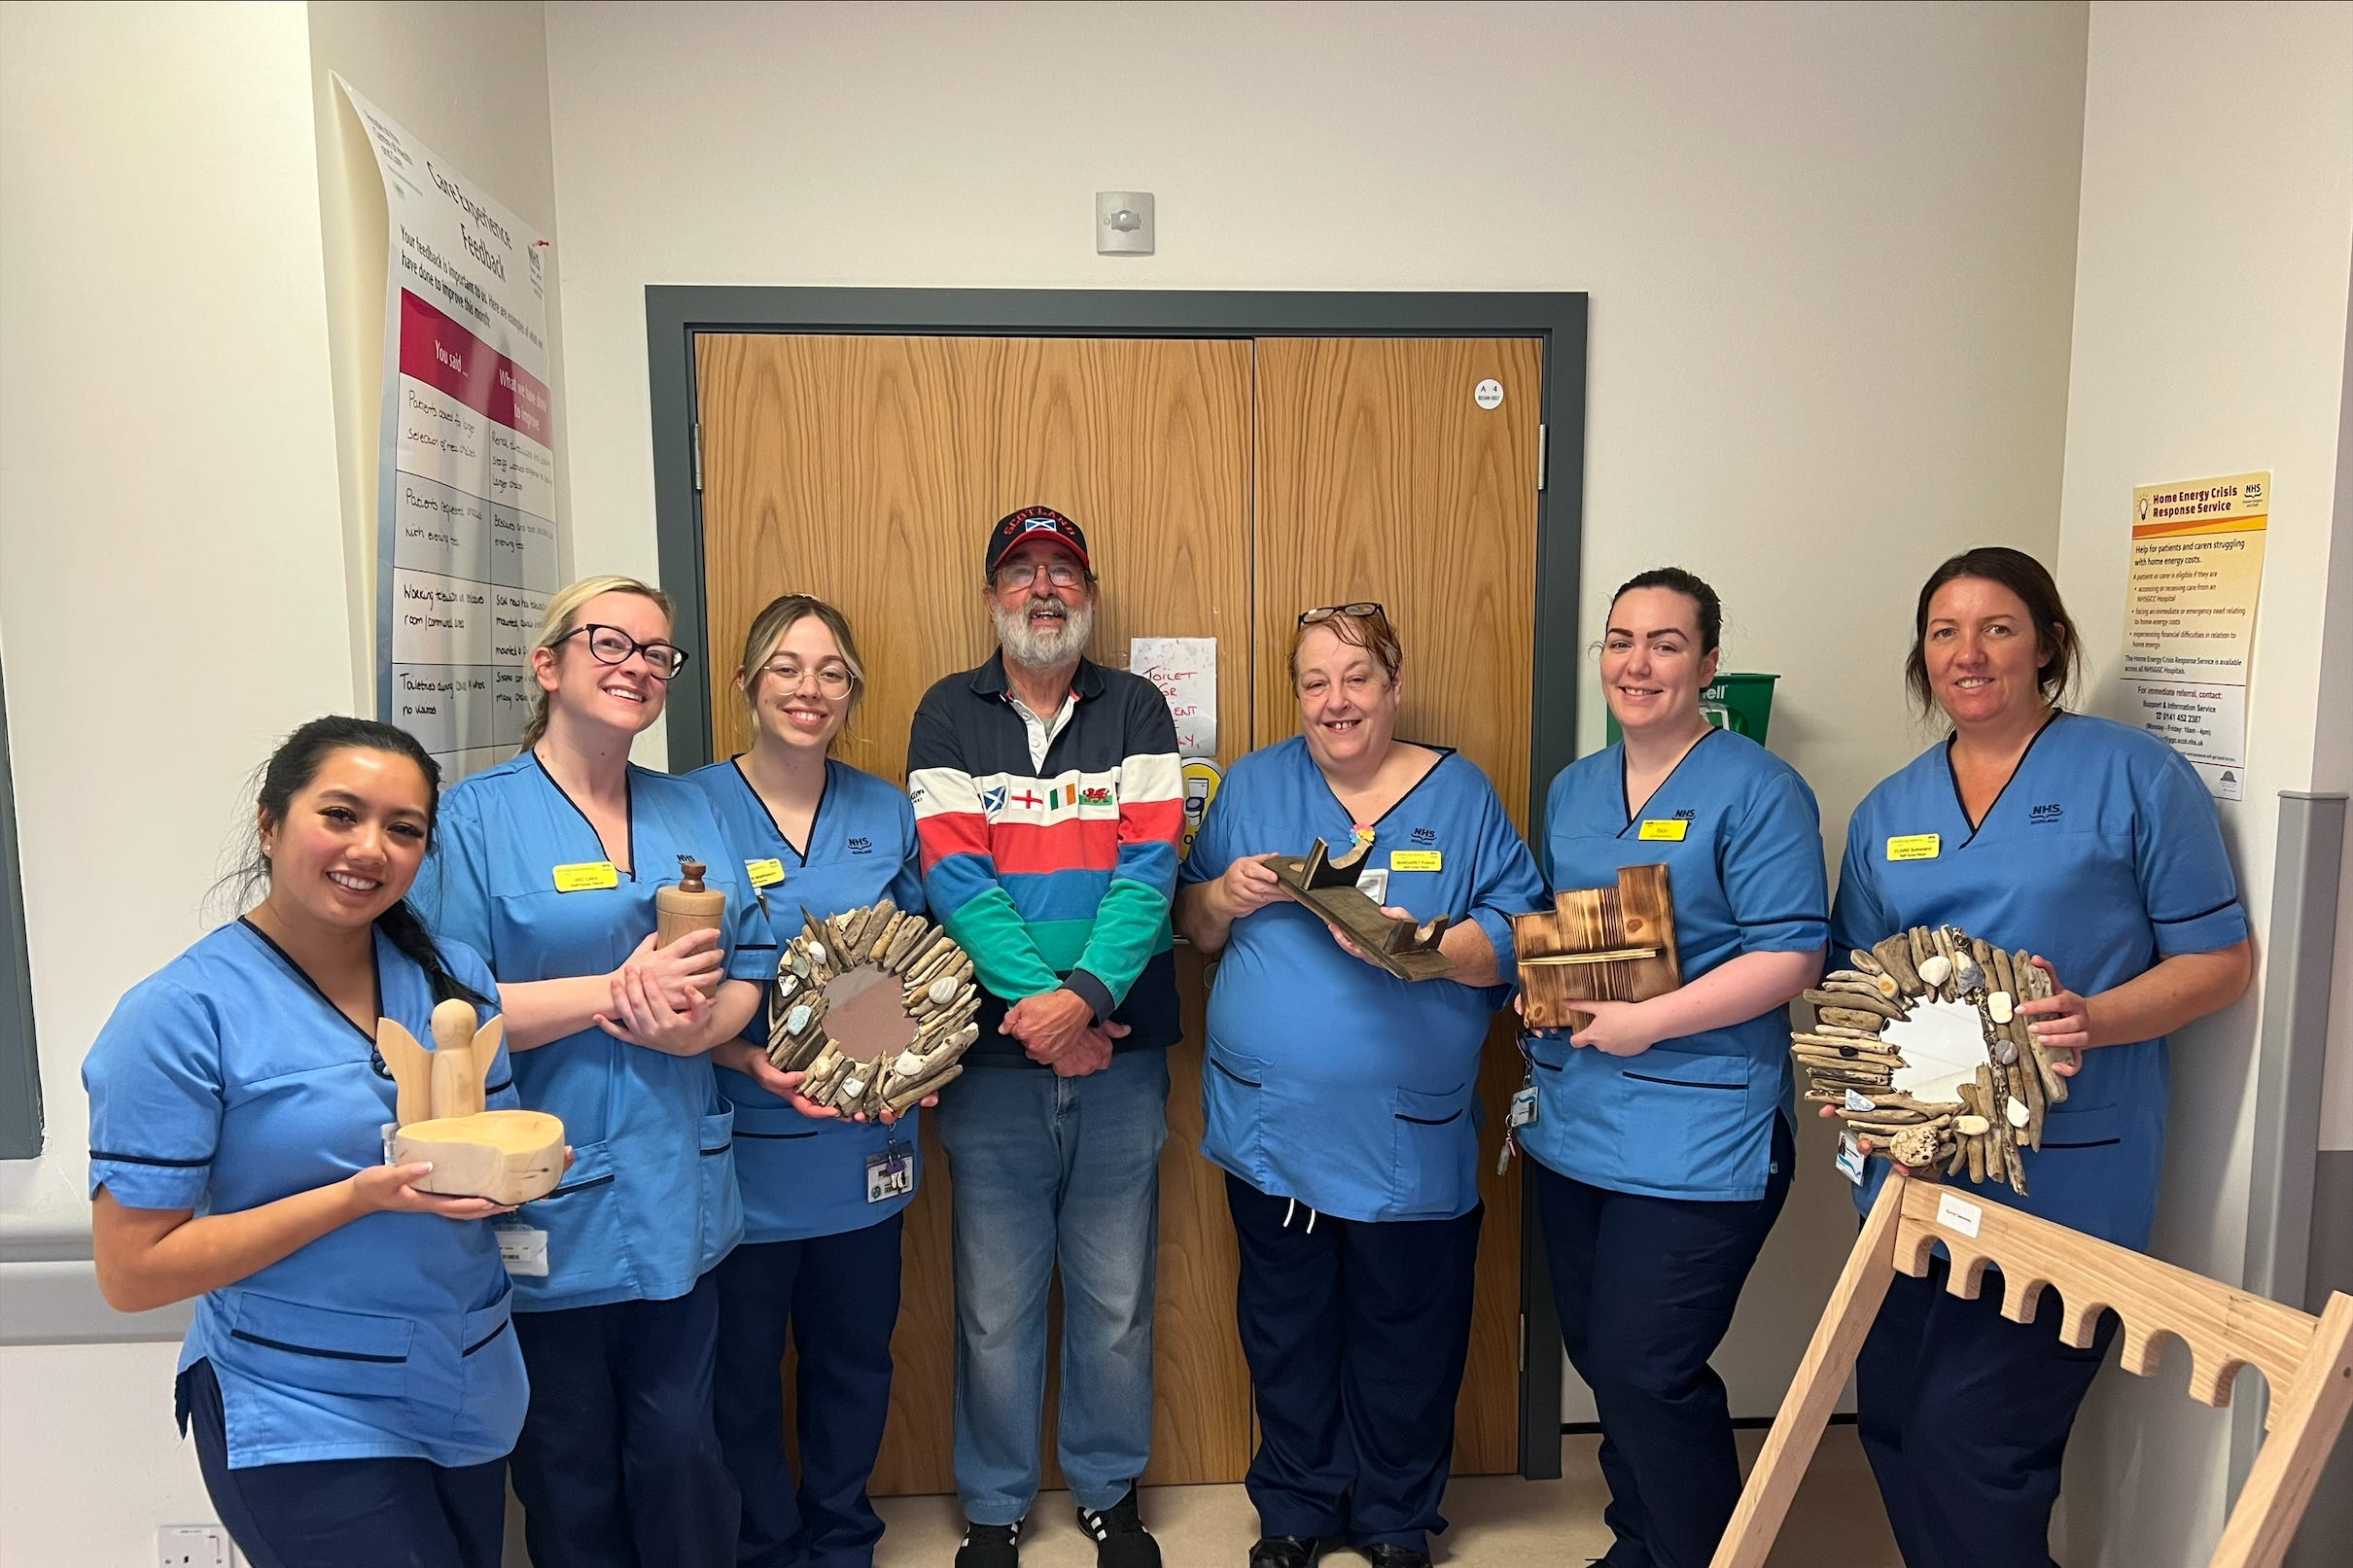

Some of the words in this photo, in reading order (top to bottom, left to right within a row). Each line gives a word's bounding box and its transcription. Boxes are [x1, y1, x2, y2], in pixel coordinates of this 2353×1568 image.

[427, 160, 459, 204] Care
[454, 184, 511, 251] Experience
[461, 223, 506, 283] Feedback
[401, 224, 415, 249] Your
[416, 236, 442, 270] feedback
[447, 261, 474, 295] important
[402, 249, 418, 276] have
[418, 262, 435, 288] done
[441, 279, 465, 309] improve
[464, 296, 474, 316] this
[435, 338, 448, 366] You
[448, 352, 462, 373] said
[499, 367, 518, 394] What
[513, 402, 522, 420] to
[2245, 483, 2261, 494] NHS
[2153, 493, 2177, 505] Home
[2179, 490, 2209, 502] Energy
[2211, 485, 2237, 498] Crisis
[2153, 503, 2195, 518] Response
[2197, 501, 2231, 513] Service
[1003, 507, 1075, 536] SCOTLAND
[2135, 544, 2148, 555] Help
[2149, 543, 2158, 553] for
[2158, 541, 2182, 554] patients
[2182, 541, 2194, 551] and
[2195, 541, 2212, 550] carers
[2213, 539, 2245, 551] struggling
[2134, 557, 2147, 566] with
[2148, 557, 2163, 566] home
[2164, 556, 2184, 567] energy
[2137, 573, 2153, 581] patient
[2176, 571, 2193, 580] eligible
[2197, 571, 2208, 580] they
[2157, 594, 2176, 603] Hospital
[2226, 607, 2246, 616] relating
[2147, 655, 2162, 665] Energy
[2175, 656, 2196, 666] Response
[2138, 685, 2148, 695] For
[2148, 686, 2175, 696] immediate
[2143, 700, 2162, 710] Support
[2167, 702, 2195, 712] Information
[2196, 704, 2216, 714] Service
[1675, 809, 1696, 818] NHS
[2033, 804, 2060, 815] NHS
[1414, 827, 1435, 837] NHS
[849, 837, 869, 846] NHS
[677, 854, 695, 862] NHS
